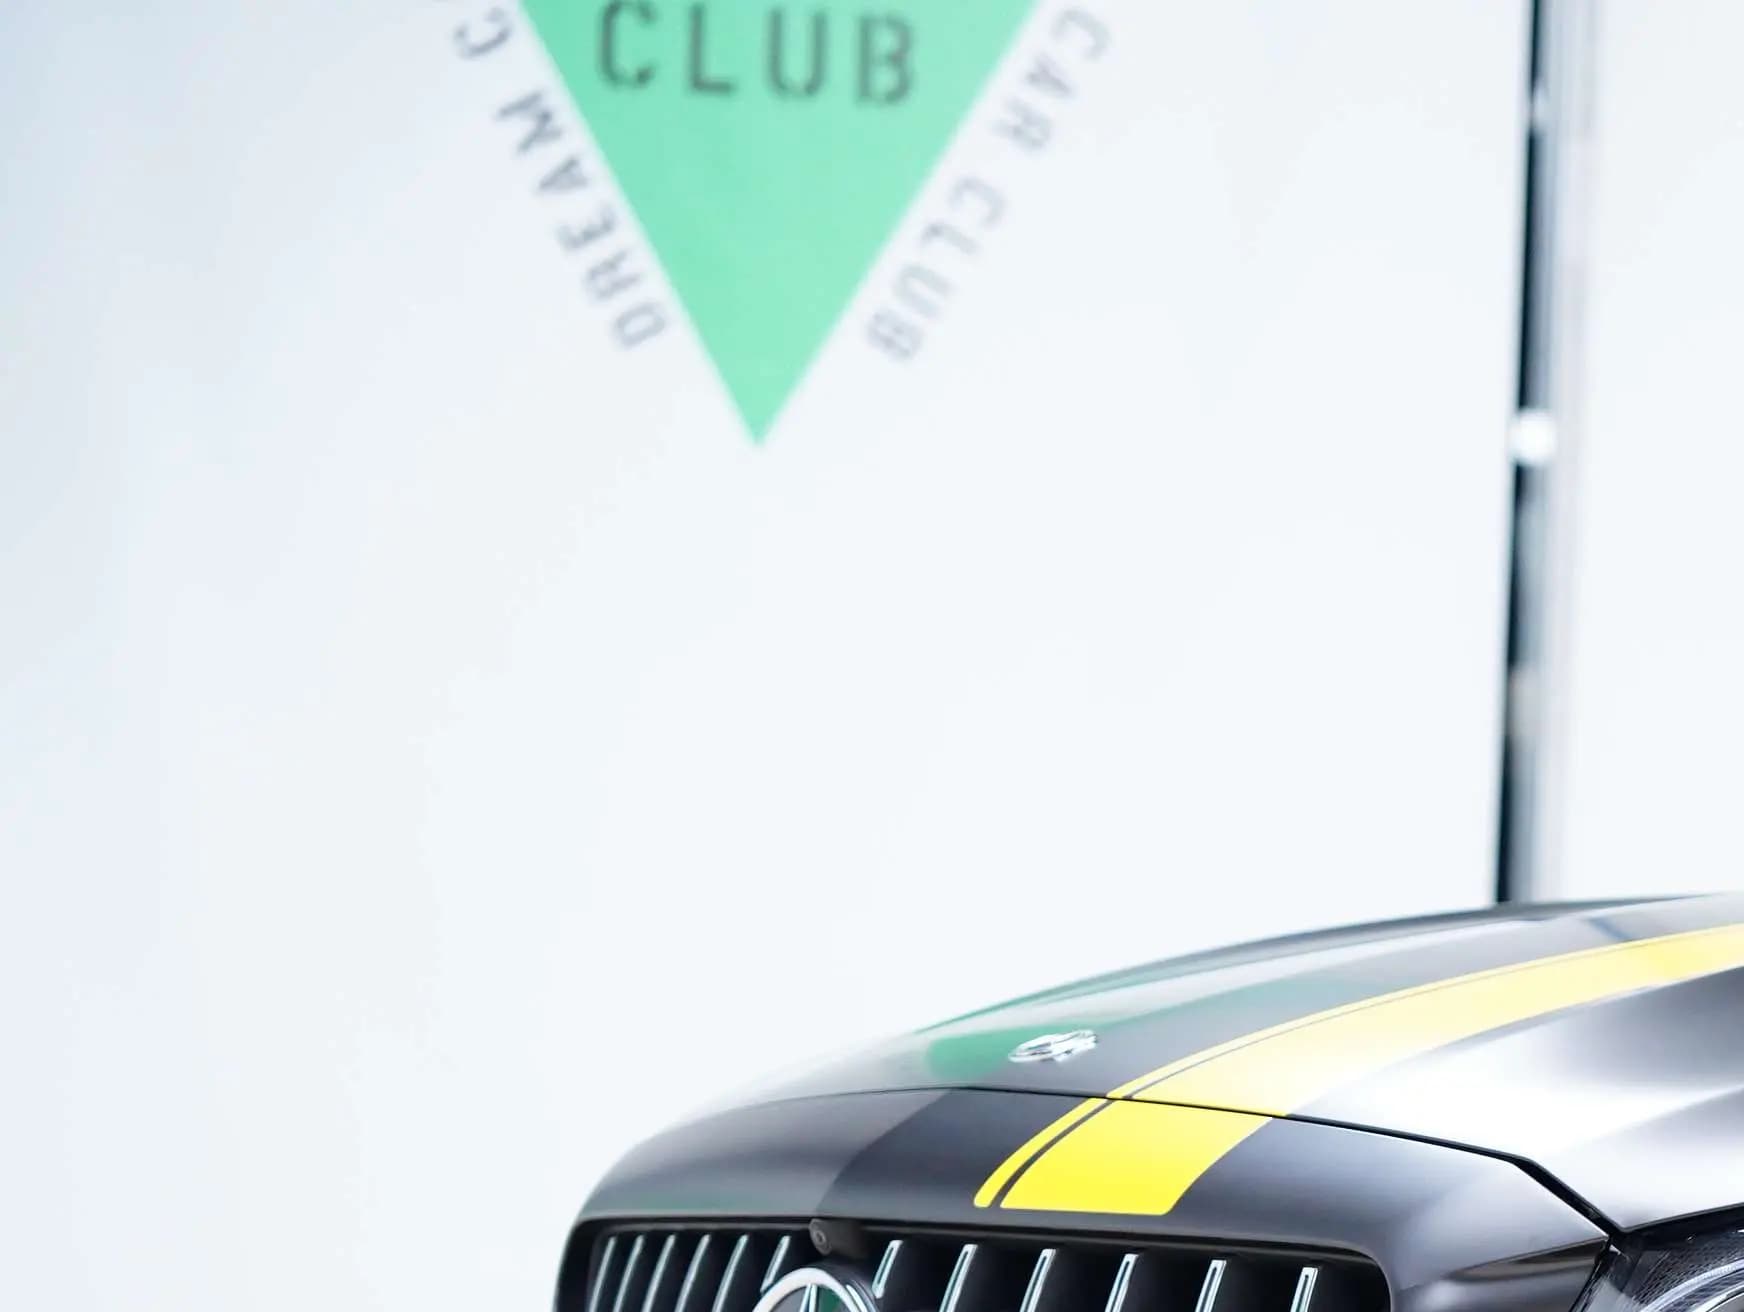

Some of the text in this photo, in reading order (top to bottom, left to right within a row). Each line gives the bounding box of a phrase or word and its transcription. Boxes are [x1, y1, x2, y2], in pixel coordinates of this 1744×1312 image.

[598, 0, 917, 105] CLUB
[495, 90, 668, 351] DREAM
[866, 5, 1112, 363] CAR CLUB
